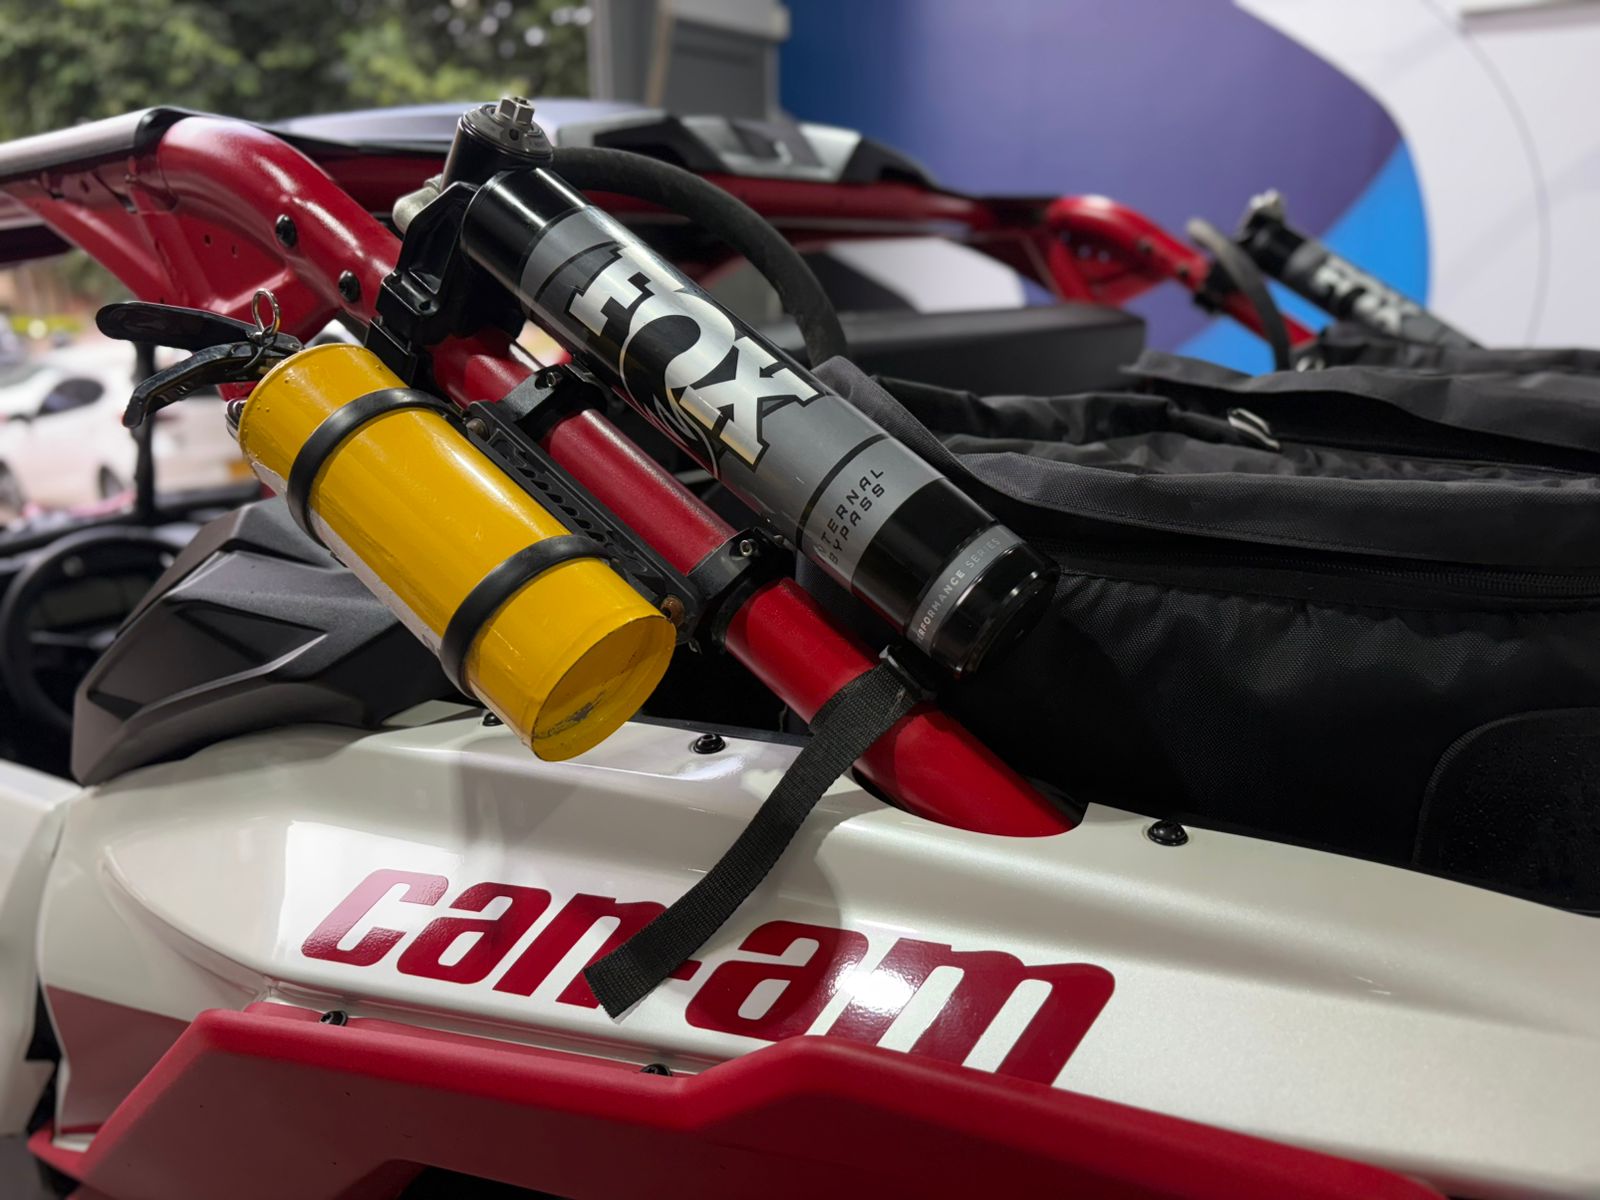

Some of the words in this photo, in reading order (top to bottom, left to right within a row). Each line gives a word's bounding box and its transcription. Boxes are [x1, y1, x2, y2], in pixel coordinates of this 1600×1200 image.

[567, 243, 821, 466] FOX
[816, 469, 884, 556] TERNAL
[829, 484, 885, 564] BYPASS
[916, 570, 966, 642] ERFORMANCE
[965, 537, 1001, 568] SERIES
